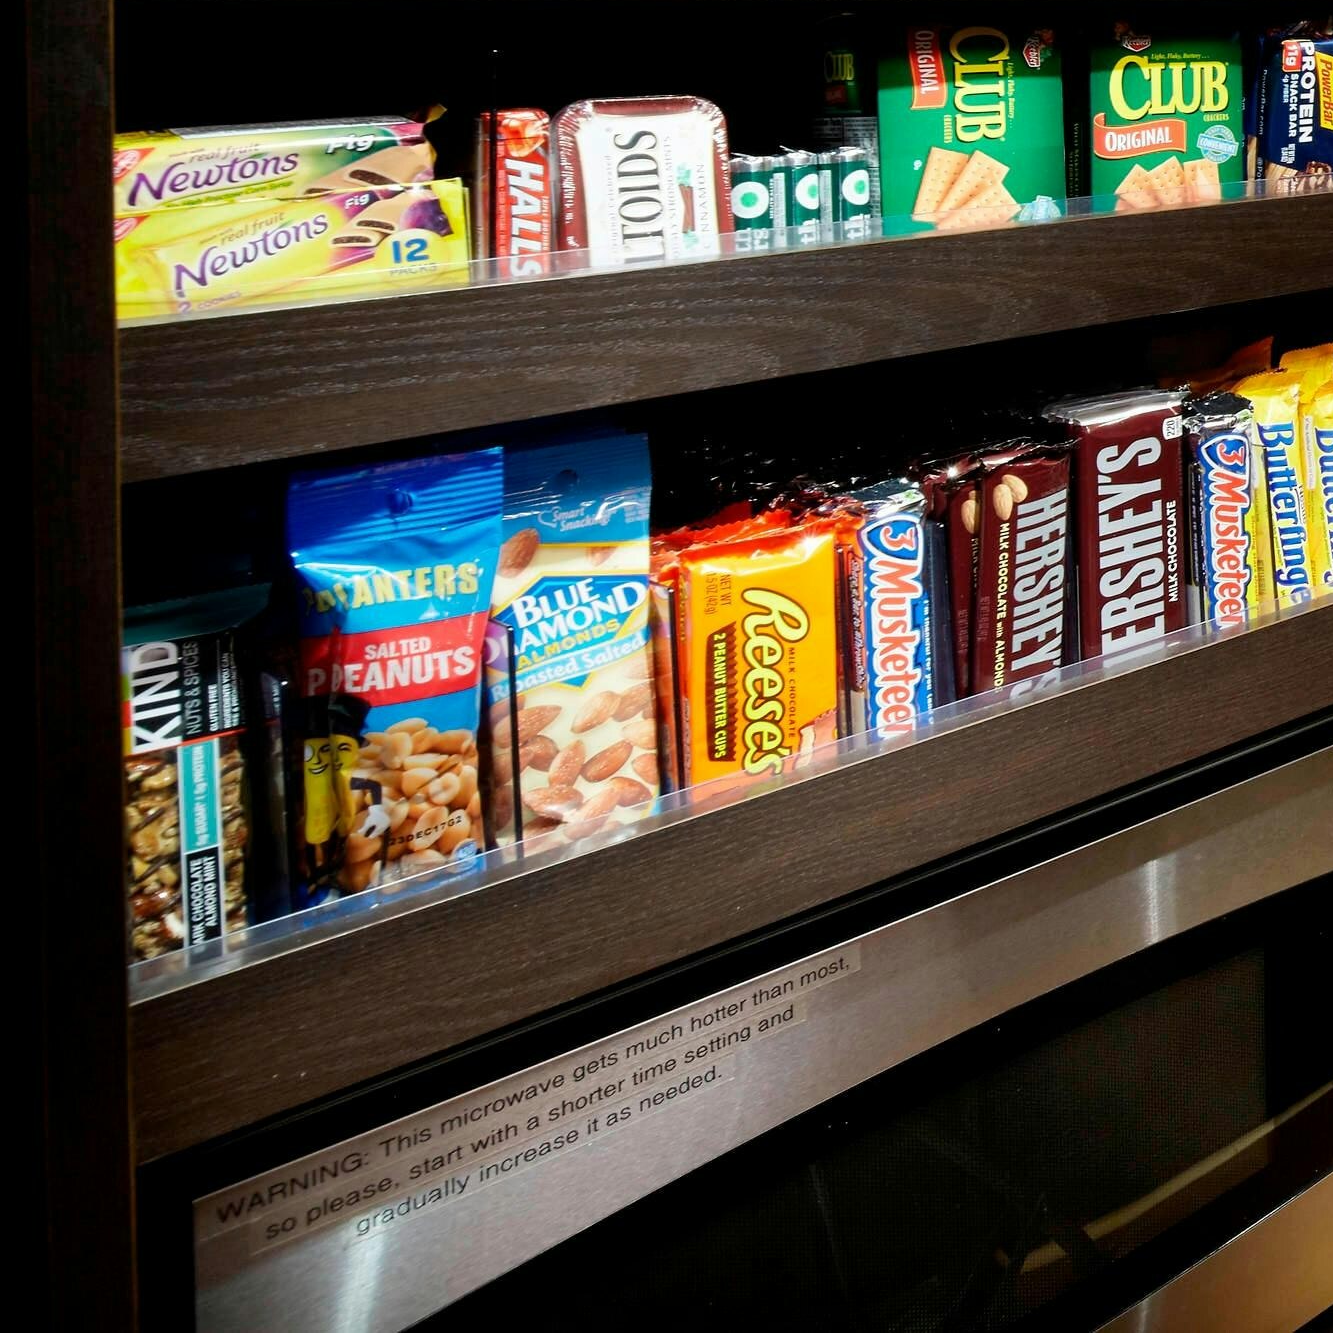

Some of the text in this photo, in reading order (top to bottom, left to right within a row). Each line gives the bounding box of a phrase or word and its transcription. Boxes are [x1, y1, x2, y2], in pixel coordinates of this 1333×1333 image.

[913, 29, 940, 96] ORIGINAL
[948, 25, 1011, 144] CLUB
[1108, 54, 1230, 121] CLUB
[1298, 39, 1316, 144] PROTEIN
[1288, 73, 1300, 138] SNACK BAR
[326, 133, 377, 155] Fig
[1104, 126, 1173, 153] ORIGINAL
[127, 151, 300, 208] Newtons
[343, 191, 371, 210] Fig
[389, 237, 430, 265] 12
[503, 158, 545, 278] HALLS
[173, 212, 330, 298] Newtons
[1218, 436, 1246, 463] 3
[879, 523, 915, 552] 3
[1256, 420, 1313, 612] Butterfinge
[995, 522, 1011, 620] MILK CHOCOLATE
[1165, 499, 1178, 602] MILK CHOCOLATE
[511, 577, 601, 629] BLUE
[1007, 488, 1068, 703] HERSHEY'S
[330, 646, 476, 695] PEANUTS
[363, 636, 432, 663] SALTED
[517, 618, 622, 671] ALMONDS
[583, 630, 646, 665] Salted
[129, 640, 183, 755] KIND
[712, 641, 727, 759] PEANUT BUTTER CUPS
[740, 587, 811, 776] Reese's
[787, 675, 797, 739] CHOCOLATE
[215, 954, 851, 1224] WARNING: This microwave gets much hotter than most,
[265, 1004, 796, 1241] so please, start with a shorter time setting and
[354, 1066, 724, 1238] gradually increase it as needed.
